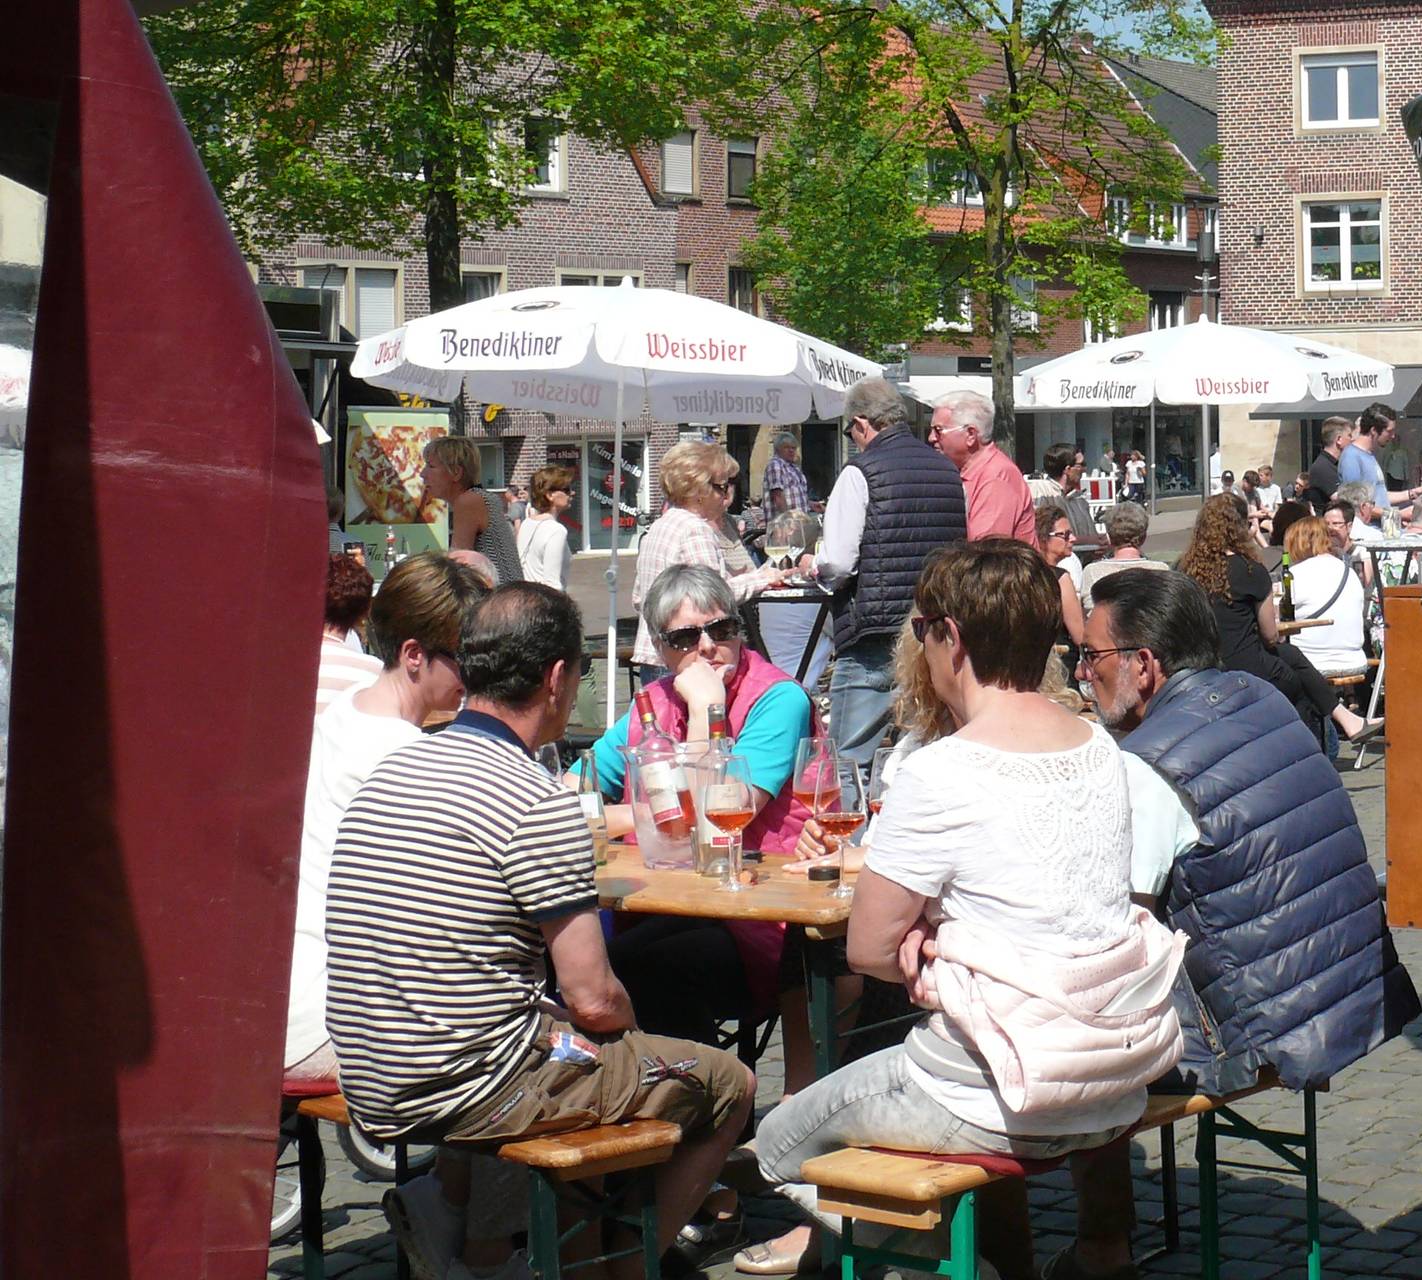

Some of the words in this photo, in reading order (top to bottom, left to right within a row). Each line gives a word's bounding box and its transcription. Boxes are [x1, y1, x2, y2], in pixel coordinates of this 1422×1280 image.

[440, 328, 563, 364] Benediktiner
[646, 332, 748, 362] Weissbier
[1060, 379, 1137, 403] Benediktiner
[1195, 376, 1270, 398] Weissbier
